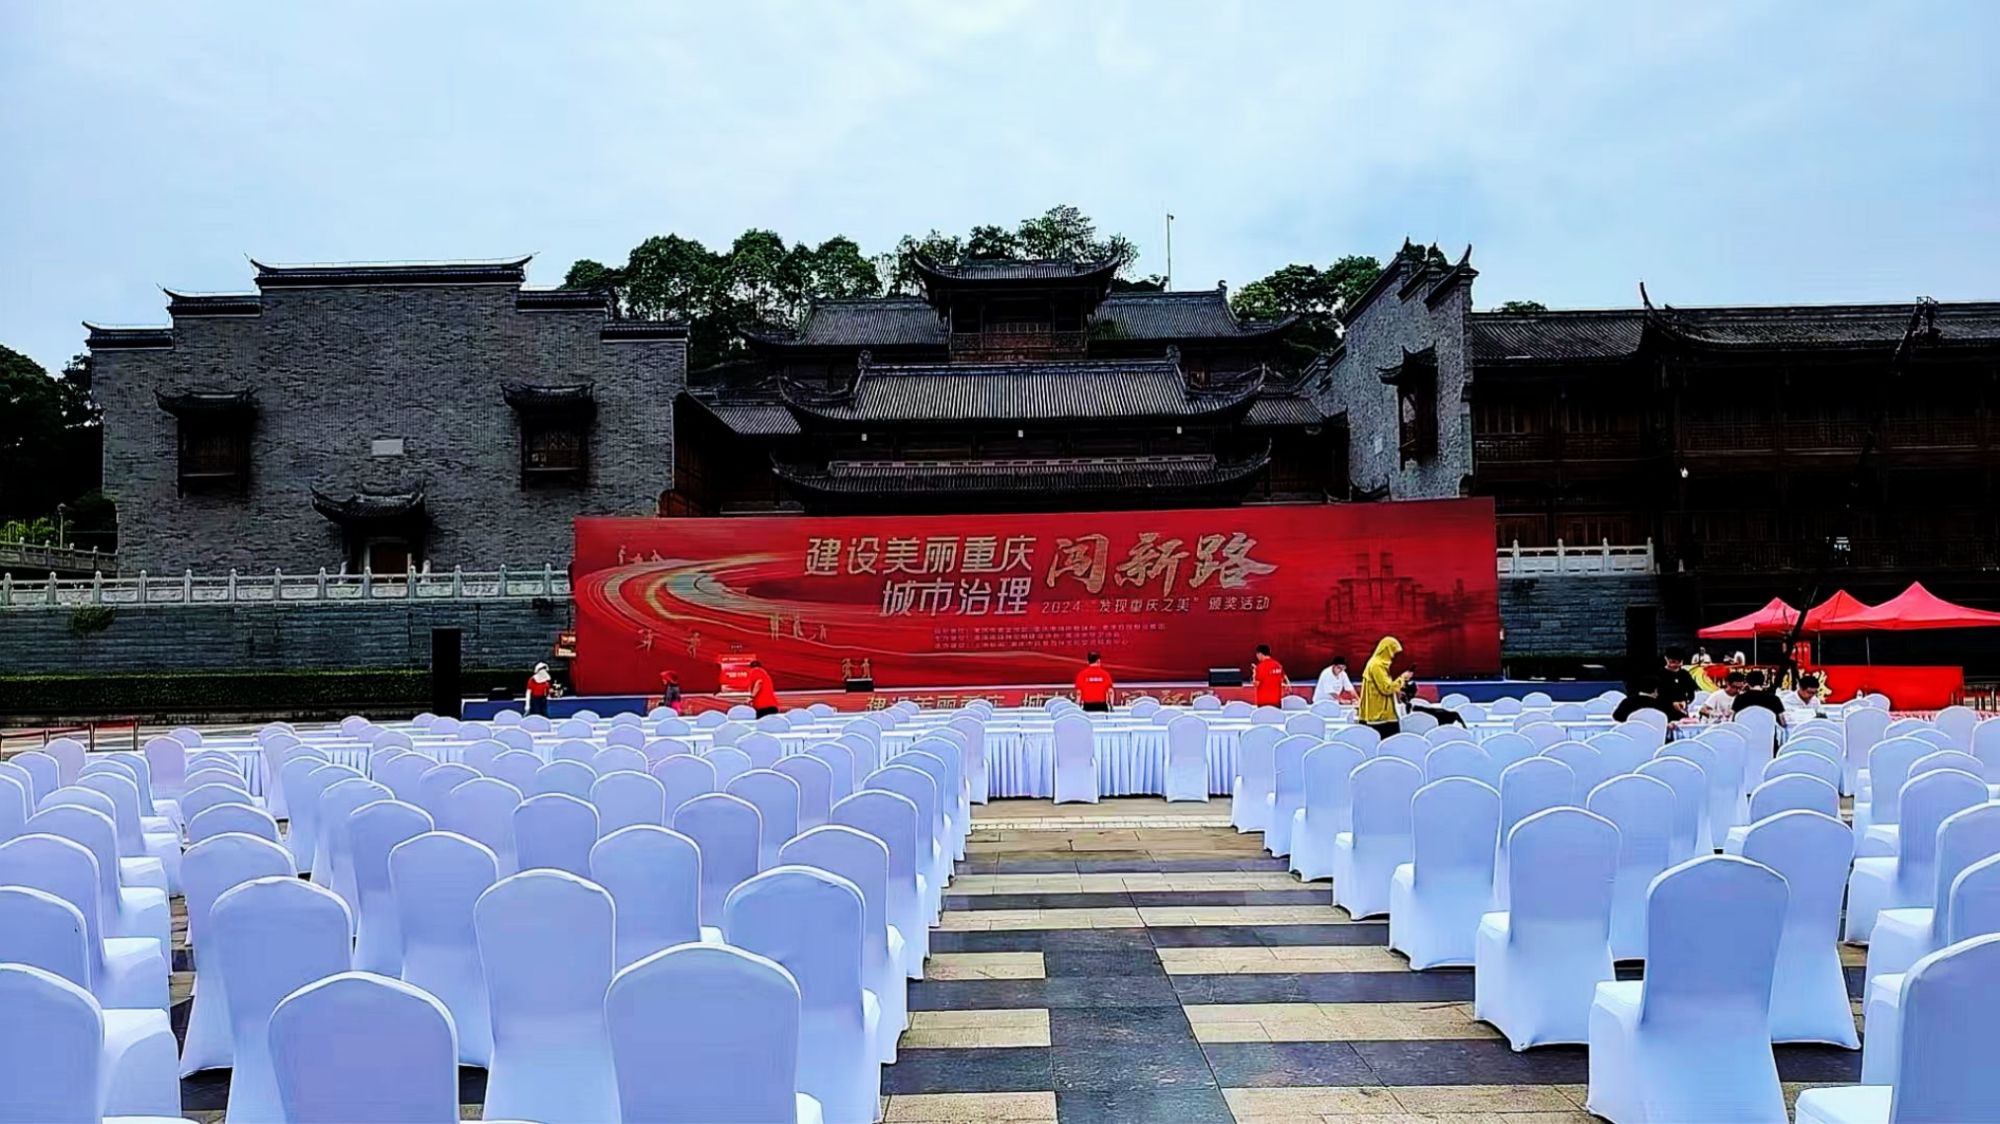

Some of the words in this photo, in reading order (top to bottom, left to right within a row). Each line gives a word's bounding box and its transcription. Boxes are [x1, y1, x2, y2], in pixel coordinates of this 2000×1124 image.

[804, 535, 1037, 576] 建设美丽重庆
[1046, 532, 1279, 597] 闯新路
[879, 577, 1032, 617] 城市治理
[1041, 601, 1081, 614] 2024
[1208, 596, 1270, 611] 颁奖活动
